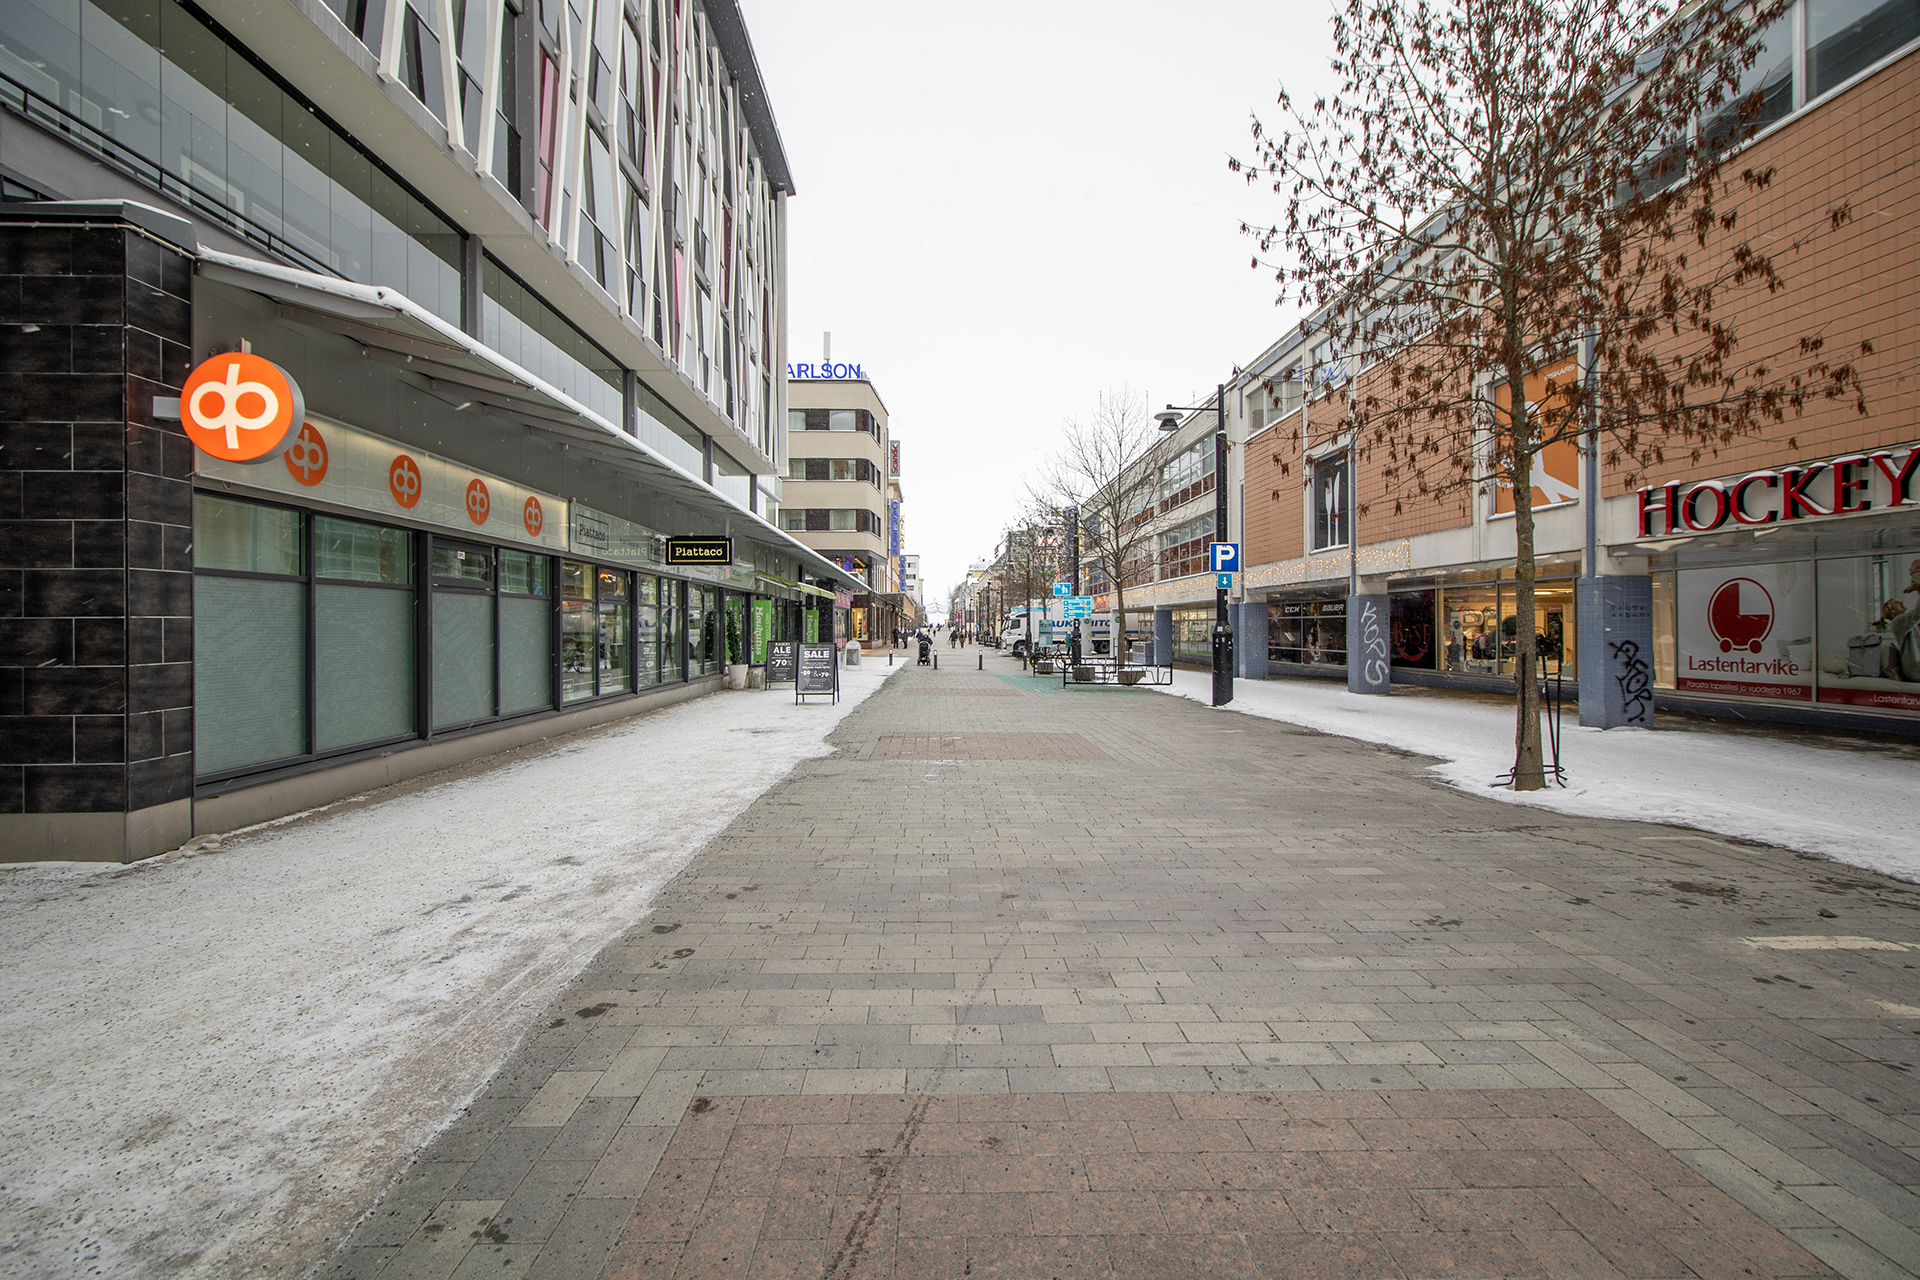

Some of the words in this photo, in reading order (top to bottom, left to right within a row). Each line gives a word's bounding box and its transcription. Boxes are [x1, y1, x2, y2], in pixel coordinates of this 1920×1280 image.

[1636, 446, 1920, 538] HOCKEY
[891, 501, 899, 555] CARLSON
[1216, 545, 1235, 571] P
[773, 646, 791, 654] ALE
[803, 650, 830, 659] SALE
[1688, 655, 1799, 676] Lastentarvike
[1686, 680, 1709, 689] Parasta
[1740, 685, 1747, 693] jo
[1747, 685, 1781, 694] vuodesta
[1783, 687, 1802, 696] 1967
